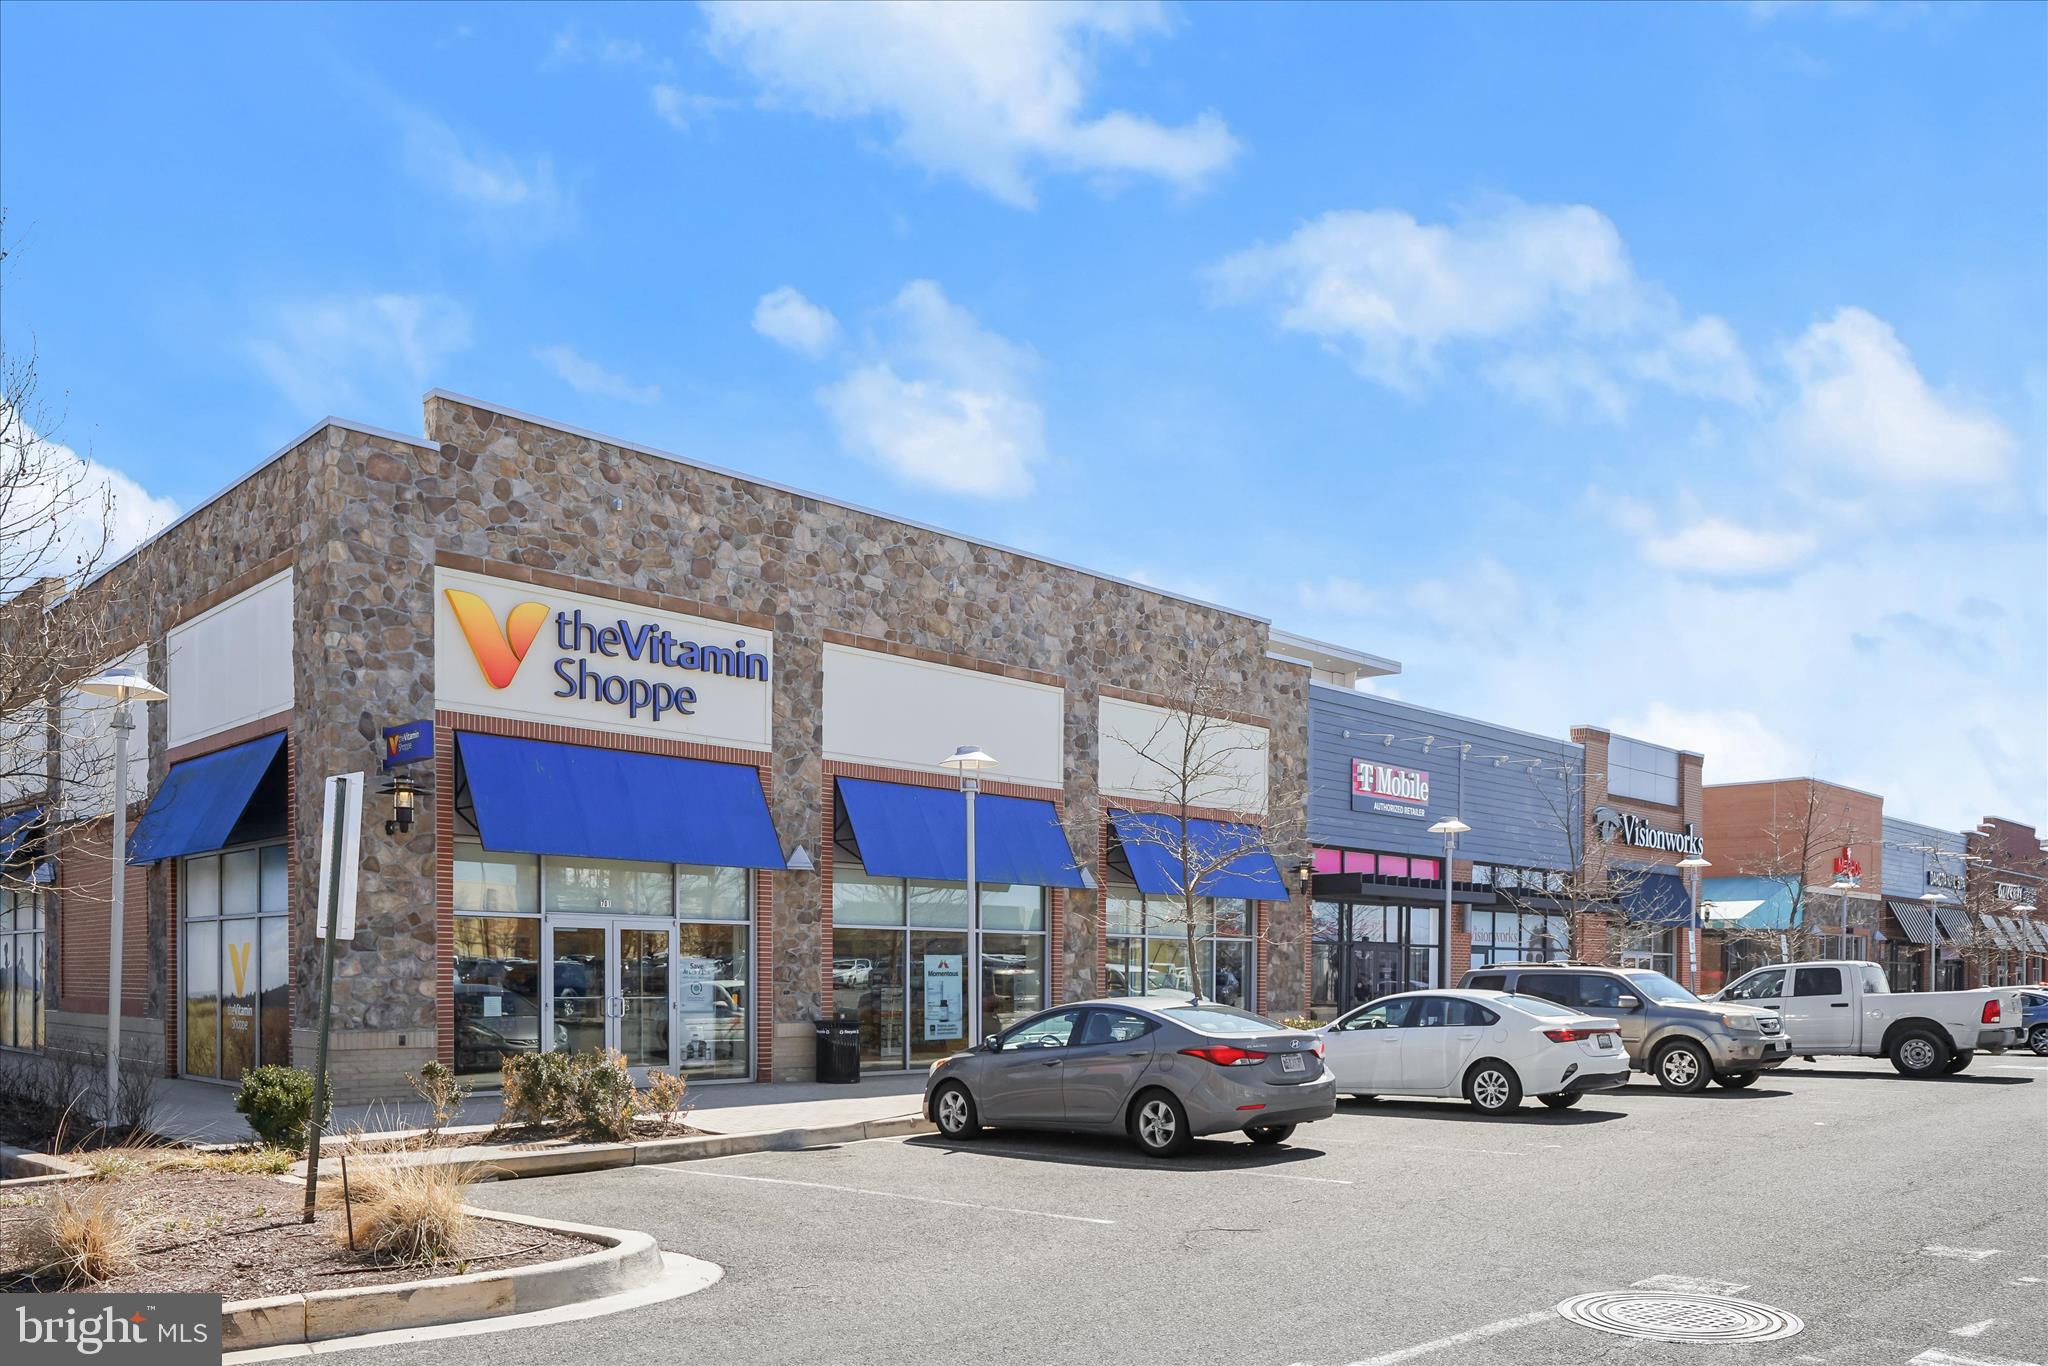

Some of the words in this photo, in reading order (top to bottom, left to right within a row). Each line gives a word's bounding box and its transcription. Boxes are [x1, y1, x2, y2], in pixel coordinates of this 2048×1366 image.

[555, 609, 769, 682] theVitamin
[553, 657, 698, 722] Shoppe
[1374, 766, 1429, 801] Mobile
[1373, 802, 1404, 814] AUTHORIZED
[1403, 806, 1426, 817] RETAILER
[1621, 813, 1704, 855] Visionworks
[1472, 926, 1518, 943] isionworks
